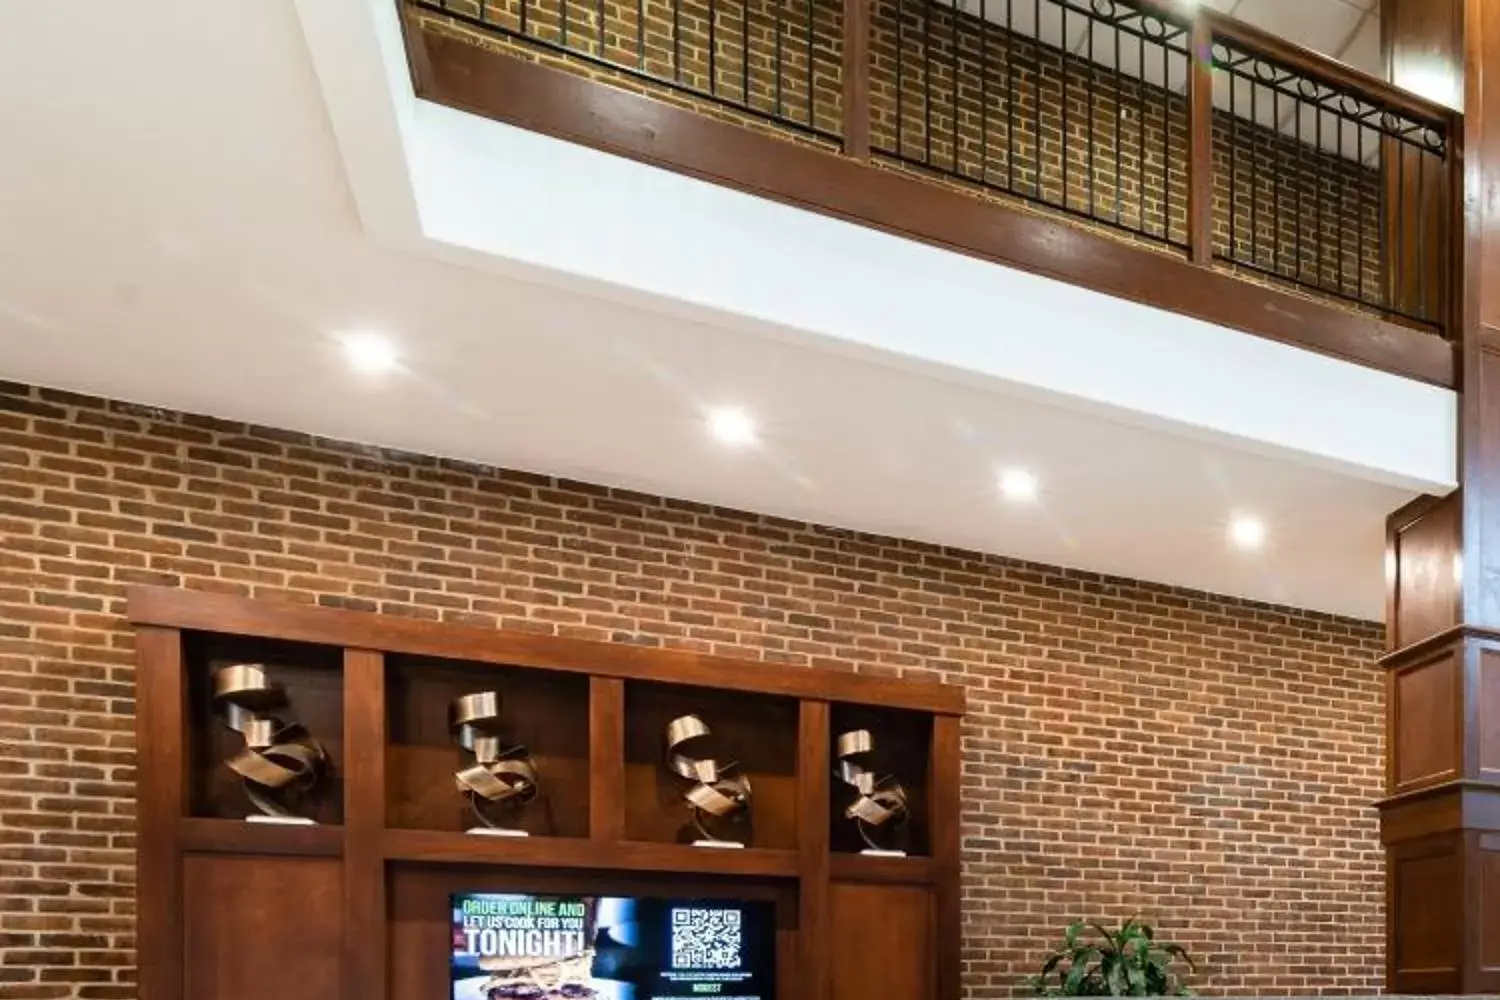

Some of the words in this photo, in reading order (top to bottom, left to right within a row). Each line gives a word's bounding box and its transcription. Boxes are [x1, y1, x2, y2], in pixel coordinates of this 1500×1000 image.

[463, 899, 508, 915] ORDER
[510, 900, 557, 916] ONLINE
[558, 903, 585, 917] AND
[463, 915, 484, 928] LET
[487, 915, 502, 929] US
[503, 916, 535, 929] COOK
[537, 917, 559, 929] FOR
[561, 917, 584, 929] YOU
[463, 928, 585, 957] TONIGHT!
